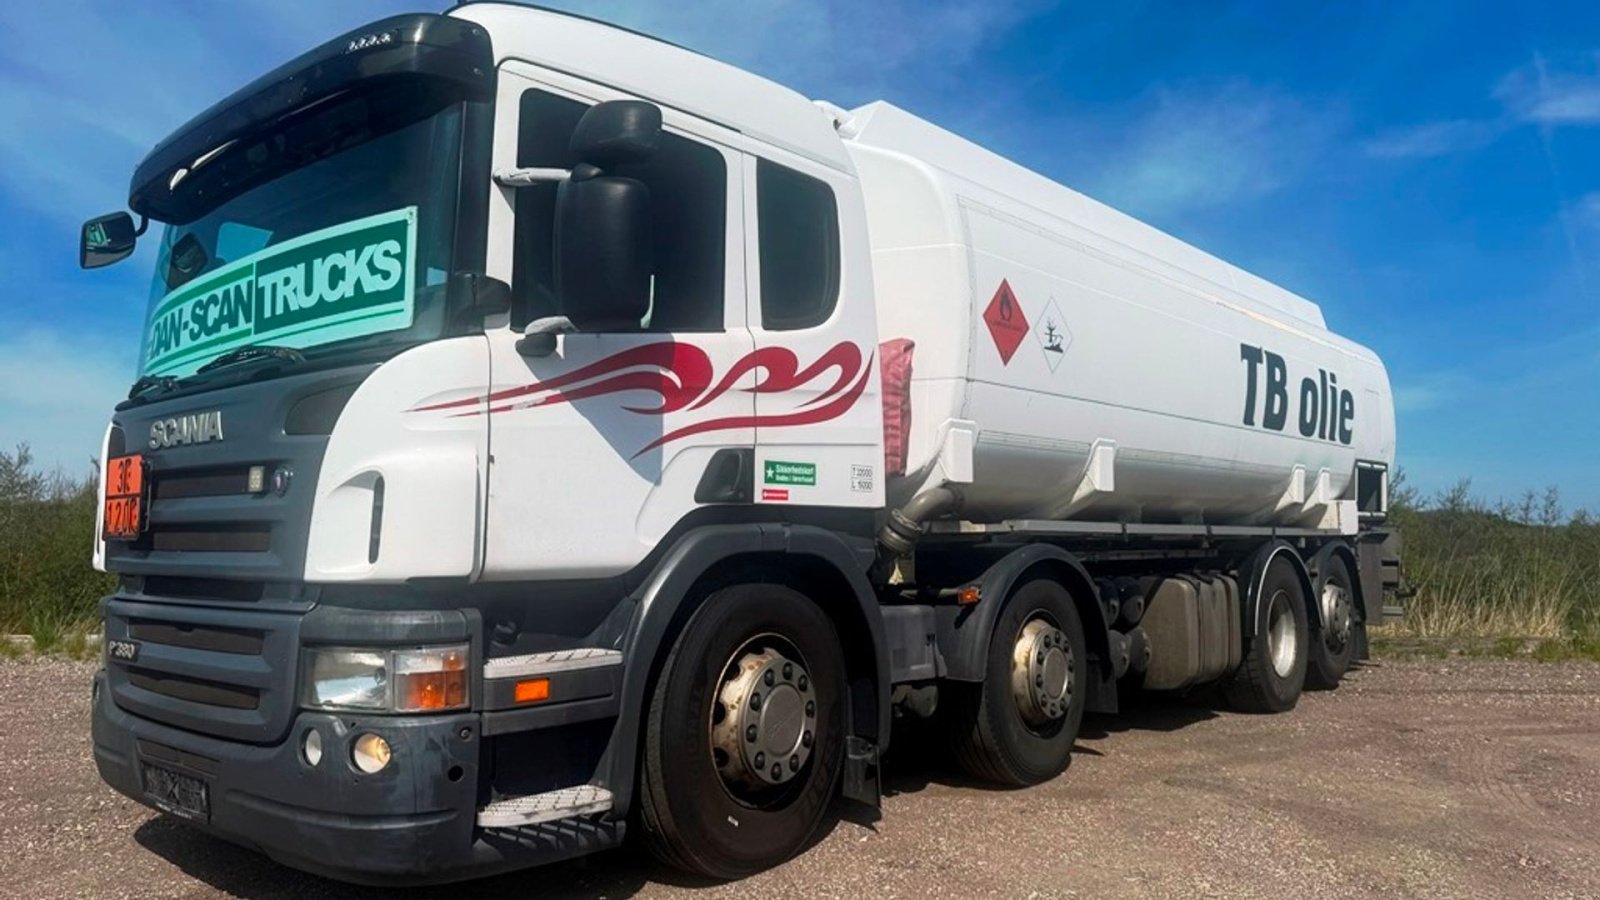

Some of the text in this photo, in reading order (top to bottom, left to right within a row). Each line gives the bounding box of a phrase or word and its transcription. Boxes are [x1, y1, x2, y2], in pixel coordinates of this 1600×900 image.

[258, 240, 401, 319] TRUCKS
[150, 411, 223, 449] SCANIA
[1240, 343, 1354, 445] TB olie
